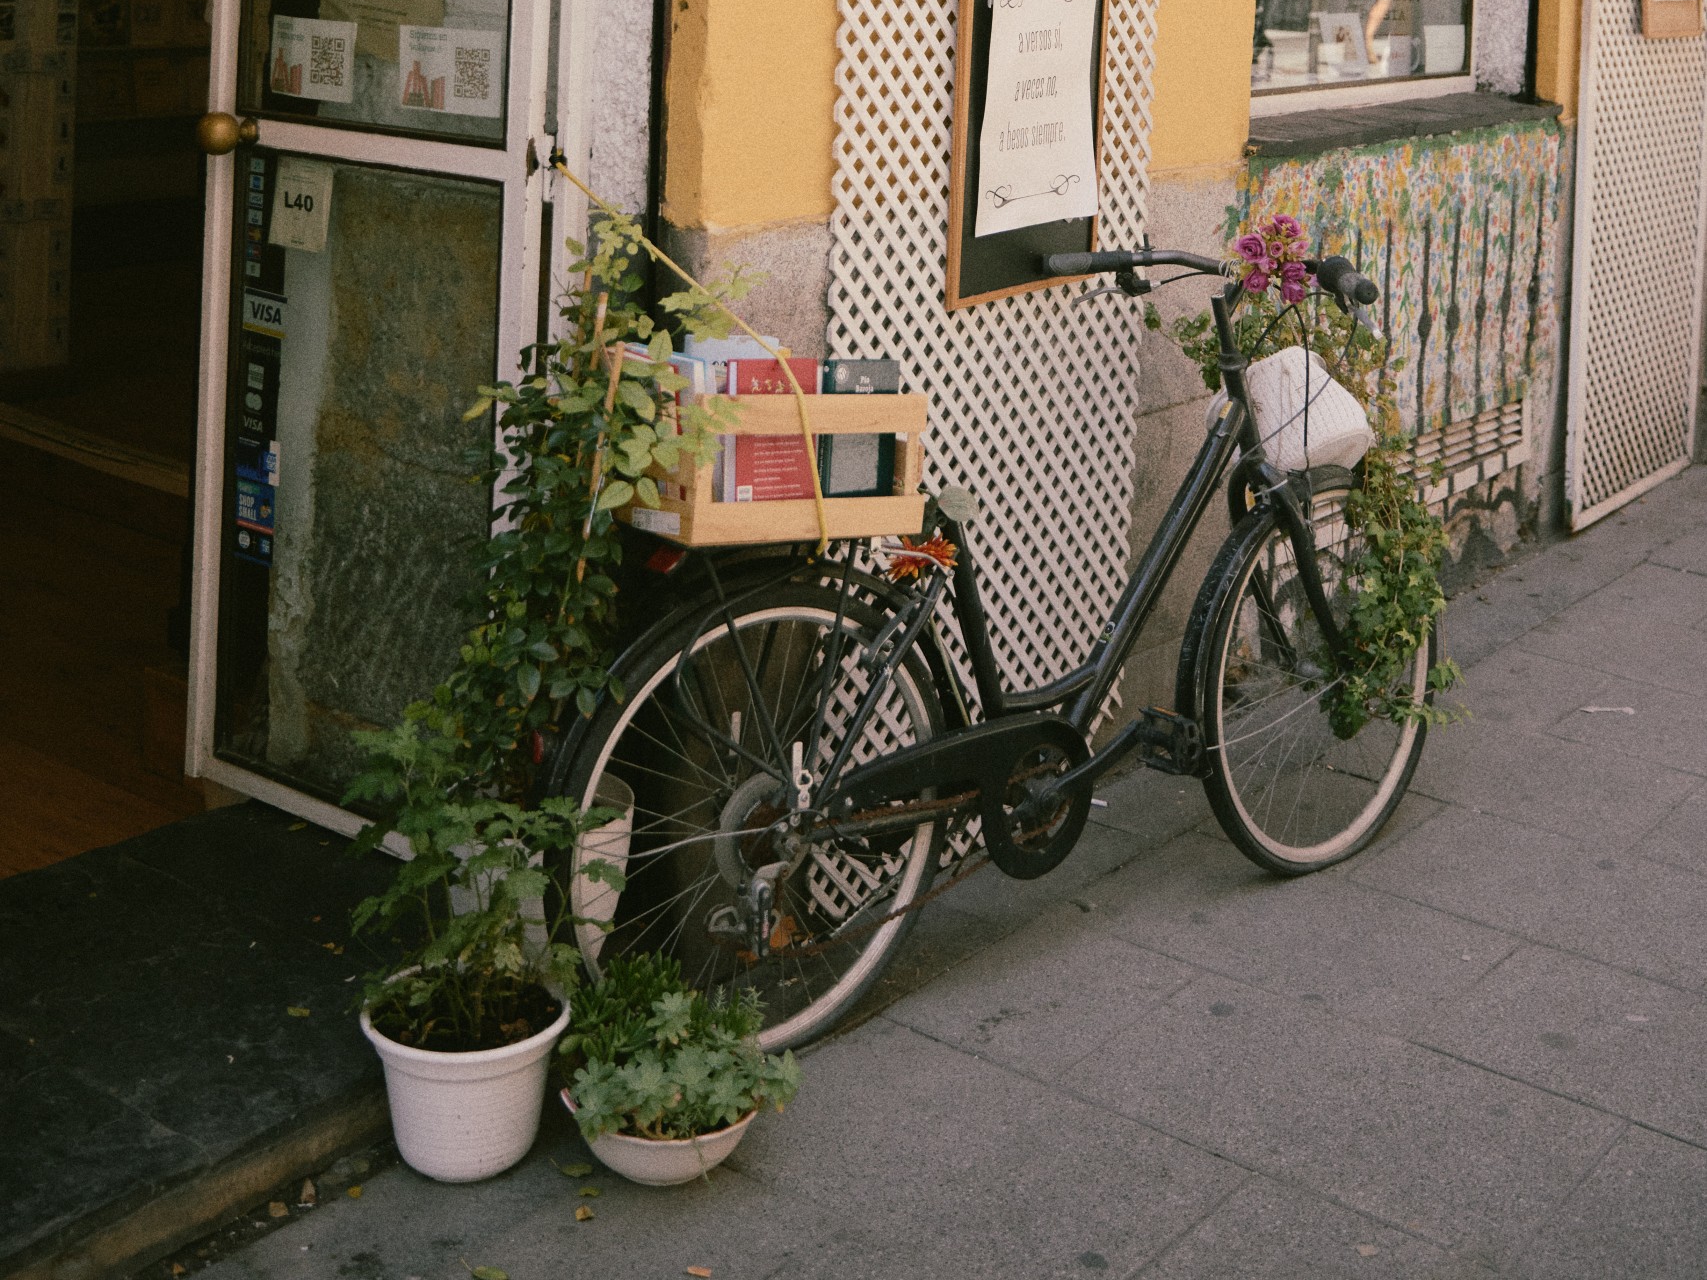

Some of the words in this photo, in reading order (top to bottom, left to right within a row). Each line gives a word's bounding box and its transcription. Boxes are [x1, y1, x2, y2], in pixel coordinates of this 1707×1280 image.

[1018, 31, 1024, 53] a
[1025, 26, 1052, 52] versos
[1054, 22, 1064, 51] sí,
[1014, 79, 1020, 102] a
[1020, 75, 1045, 101] veces
[1046, 74, 1058, 99] no,
[998, 129, 1004, 152] a
[1006, 121, 1029, 150] besos
[1031, 120, 1067, 148] siempre.
[284, 191, 314, 213] L40
[250, 301, 283, 326] VISA
[242, 415, 264, 433] VISA
[238, 493, 255, 508] SHOP
[238, 505, 257, 522] SMALL
